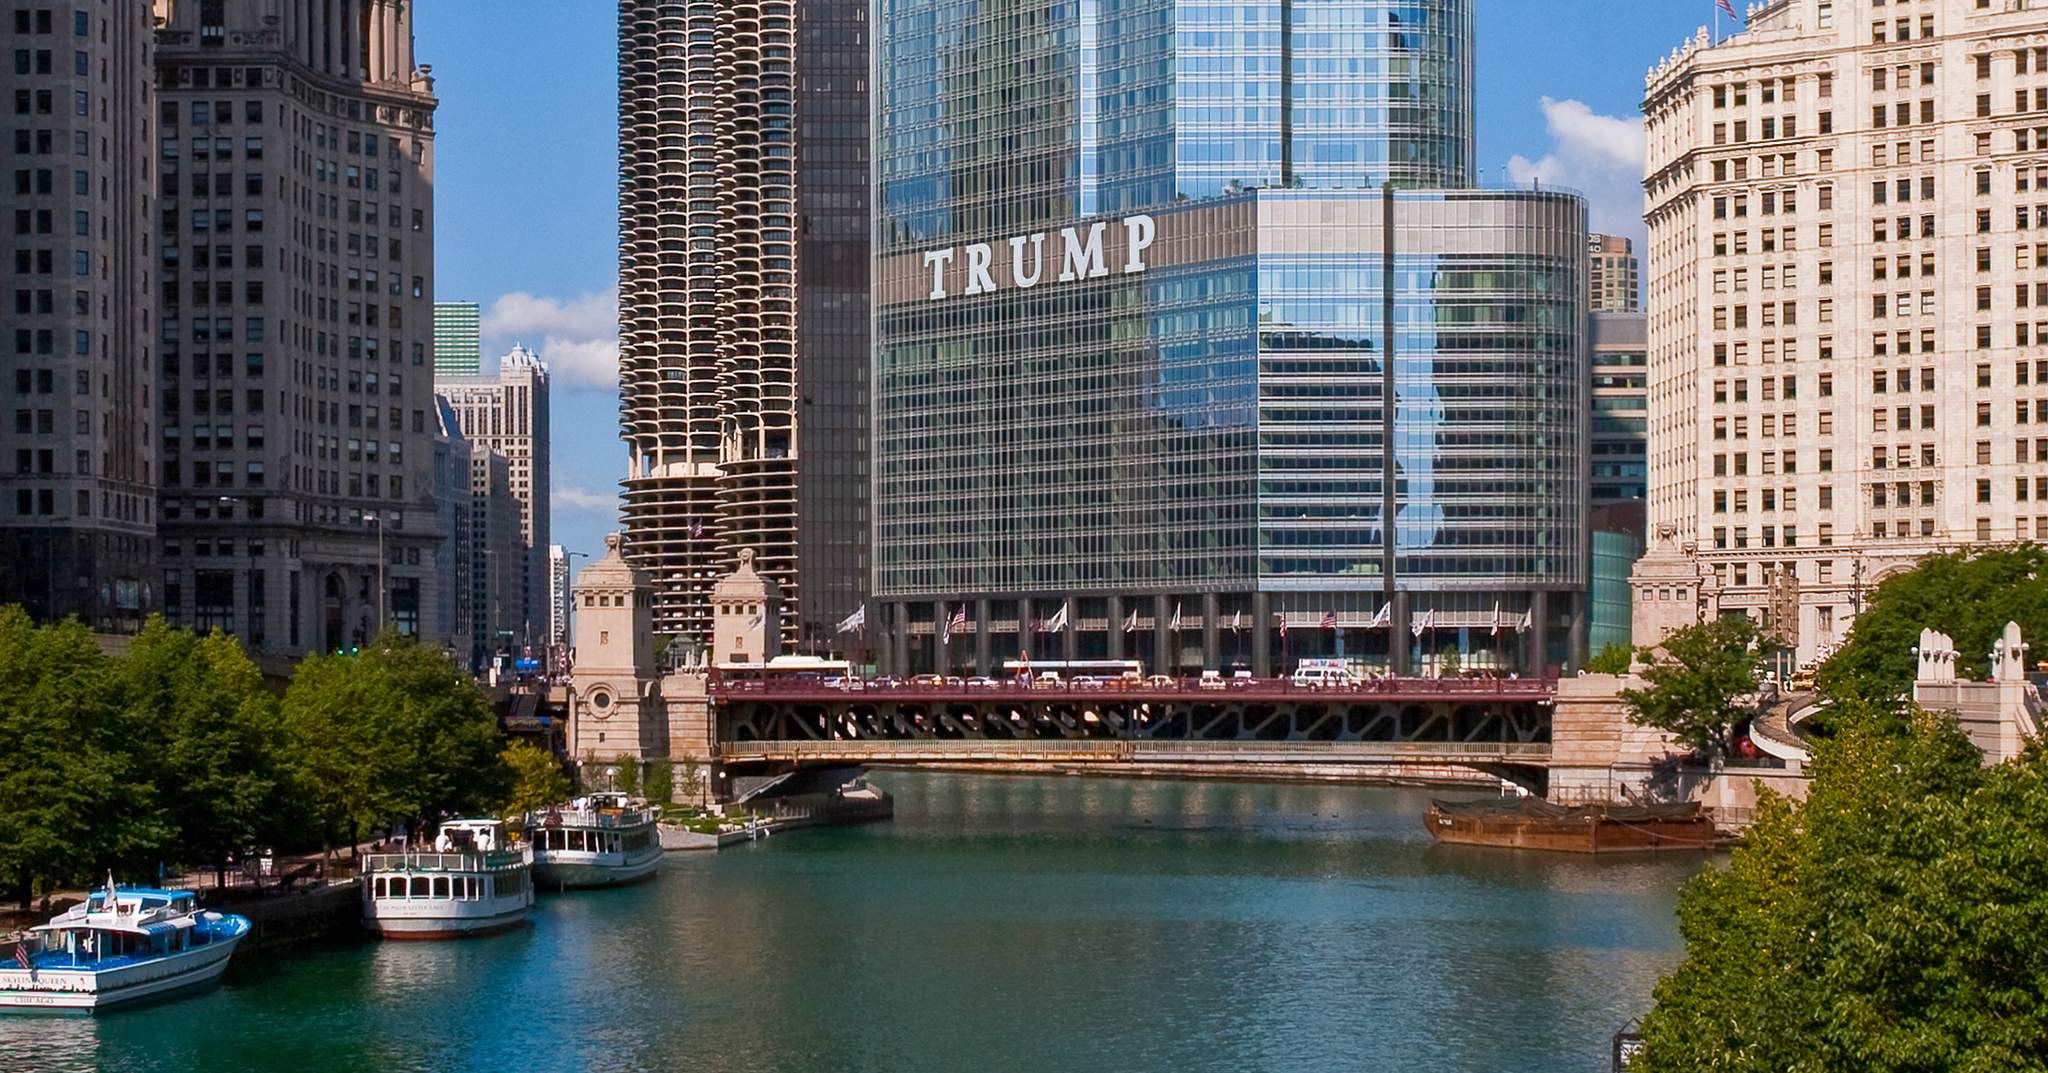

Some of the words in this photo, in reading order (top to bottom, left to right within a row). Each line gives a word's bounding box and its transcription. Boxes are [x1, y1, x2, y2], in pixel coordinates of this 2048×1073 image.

[924, 214, 1156, 300] TRUMP
[2, 976, 36, 984] SKYLIN
[38, 977, 67, 985] QUEEN
